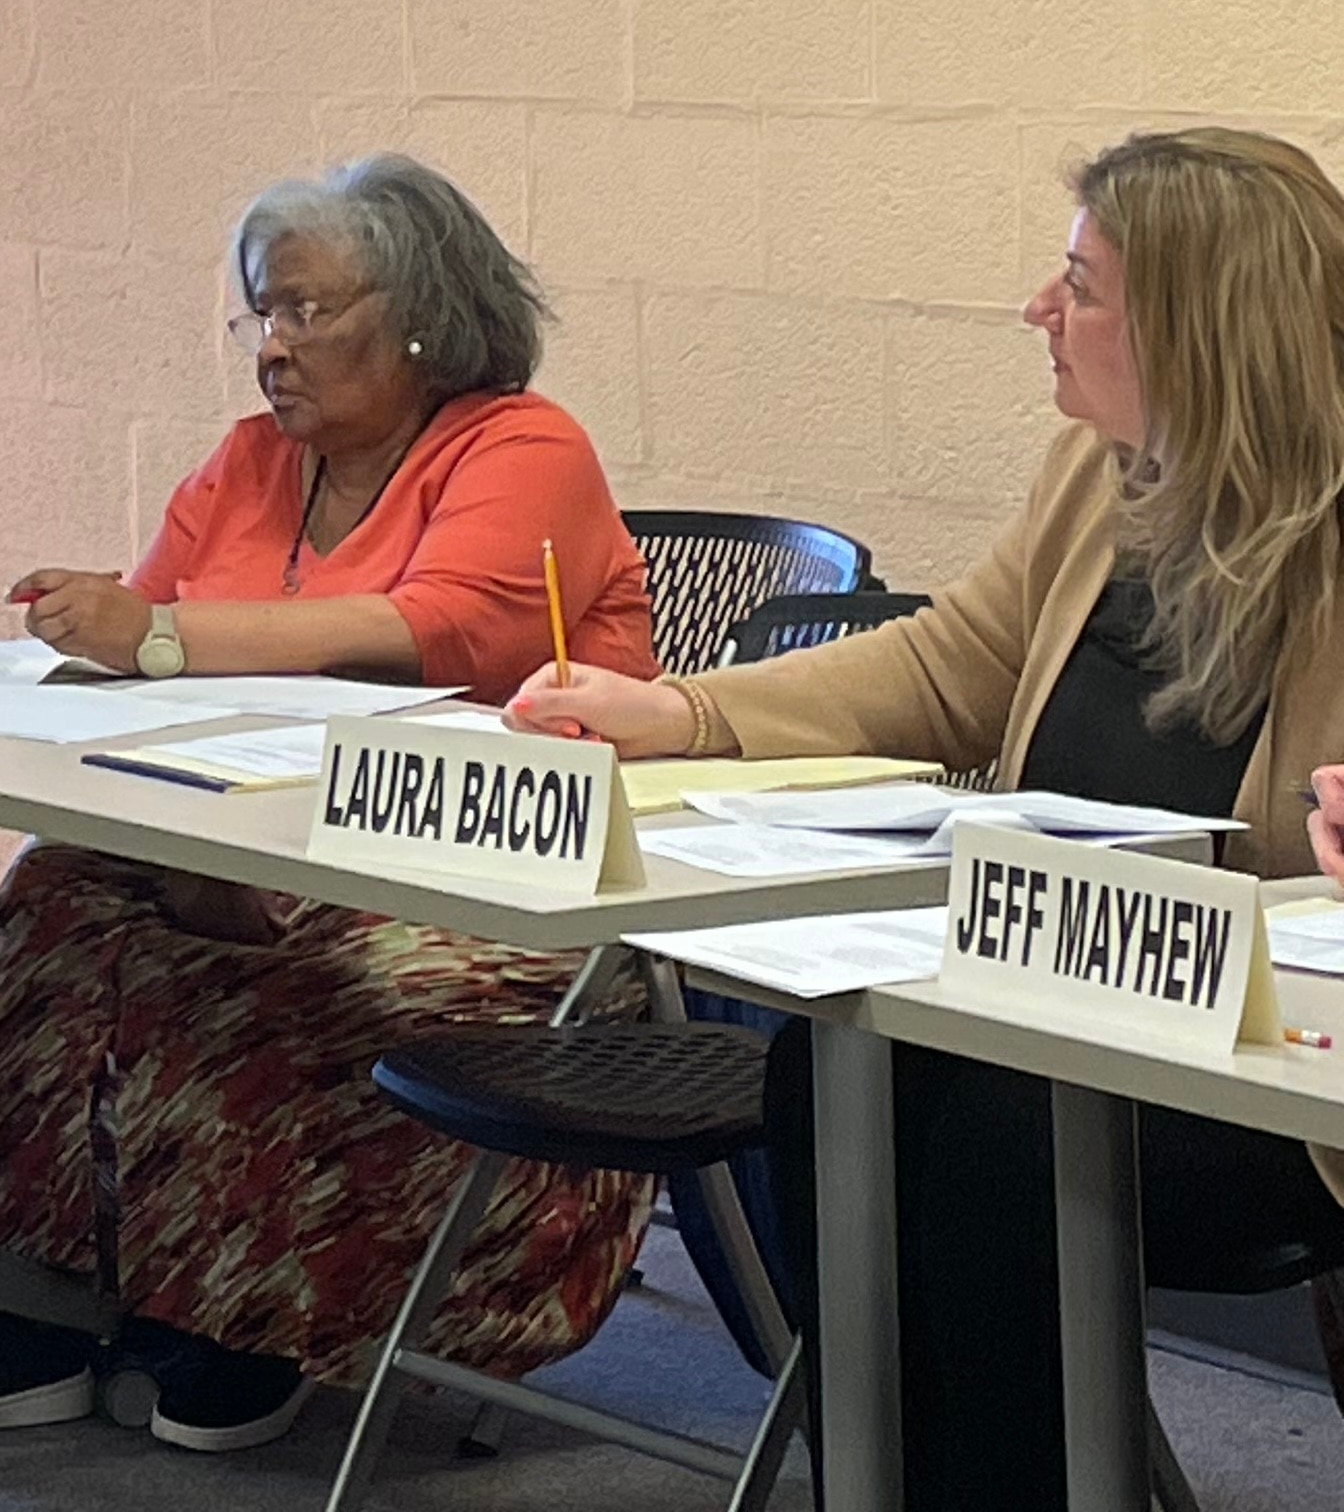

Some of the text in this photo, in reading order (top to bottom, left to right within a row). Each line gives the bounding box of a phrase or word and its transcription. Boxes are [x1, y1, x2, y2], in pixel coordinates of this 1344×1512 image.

[323, 744, 593, 860] LAURA BACON
[957, 858, 1232, 1010] JEFF MAYHEW
